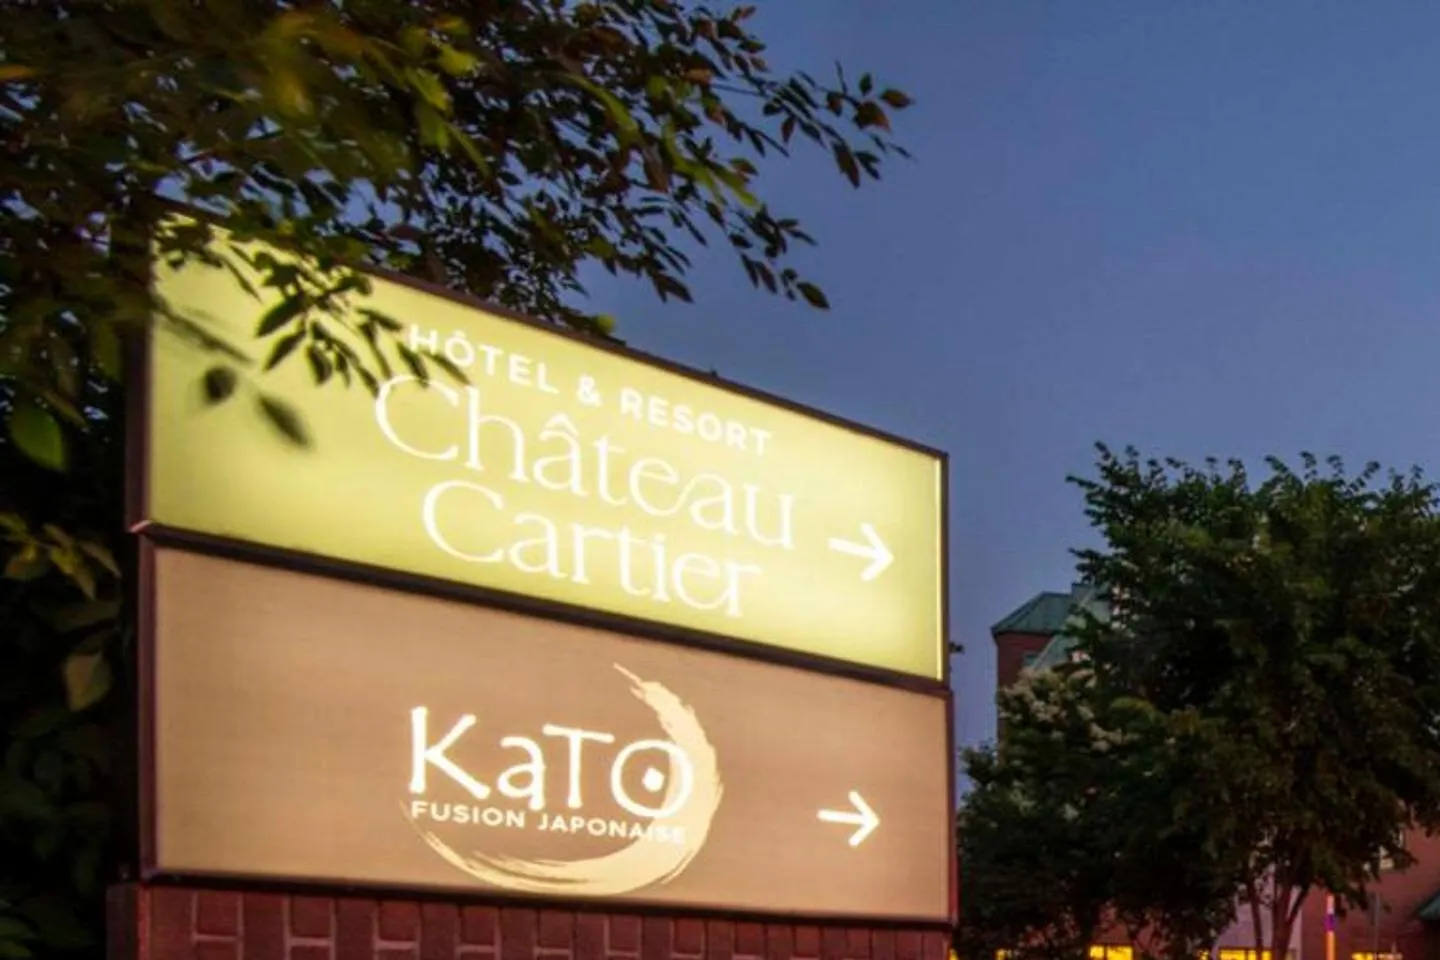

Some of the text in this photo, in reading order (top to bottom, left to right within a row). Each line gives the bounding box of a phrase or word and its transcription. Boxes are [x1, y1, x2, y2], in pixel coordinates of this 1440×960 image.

[408, 323, 772, 456] HÔTEL & RESORT
[374, 373, 795, 550] Château
[422, 479, 763, 618] Cartier
[410, 800, 687, 845] FUSION JAPONAISE
